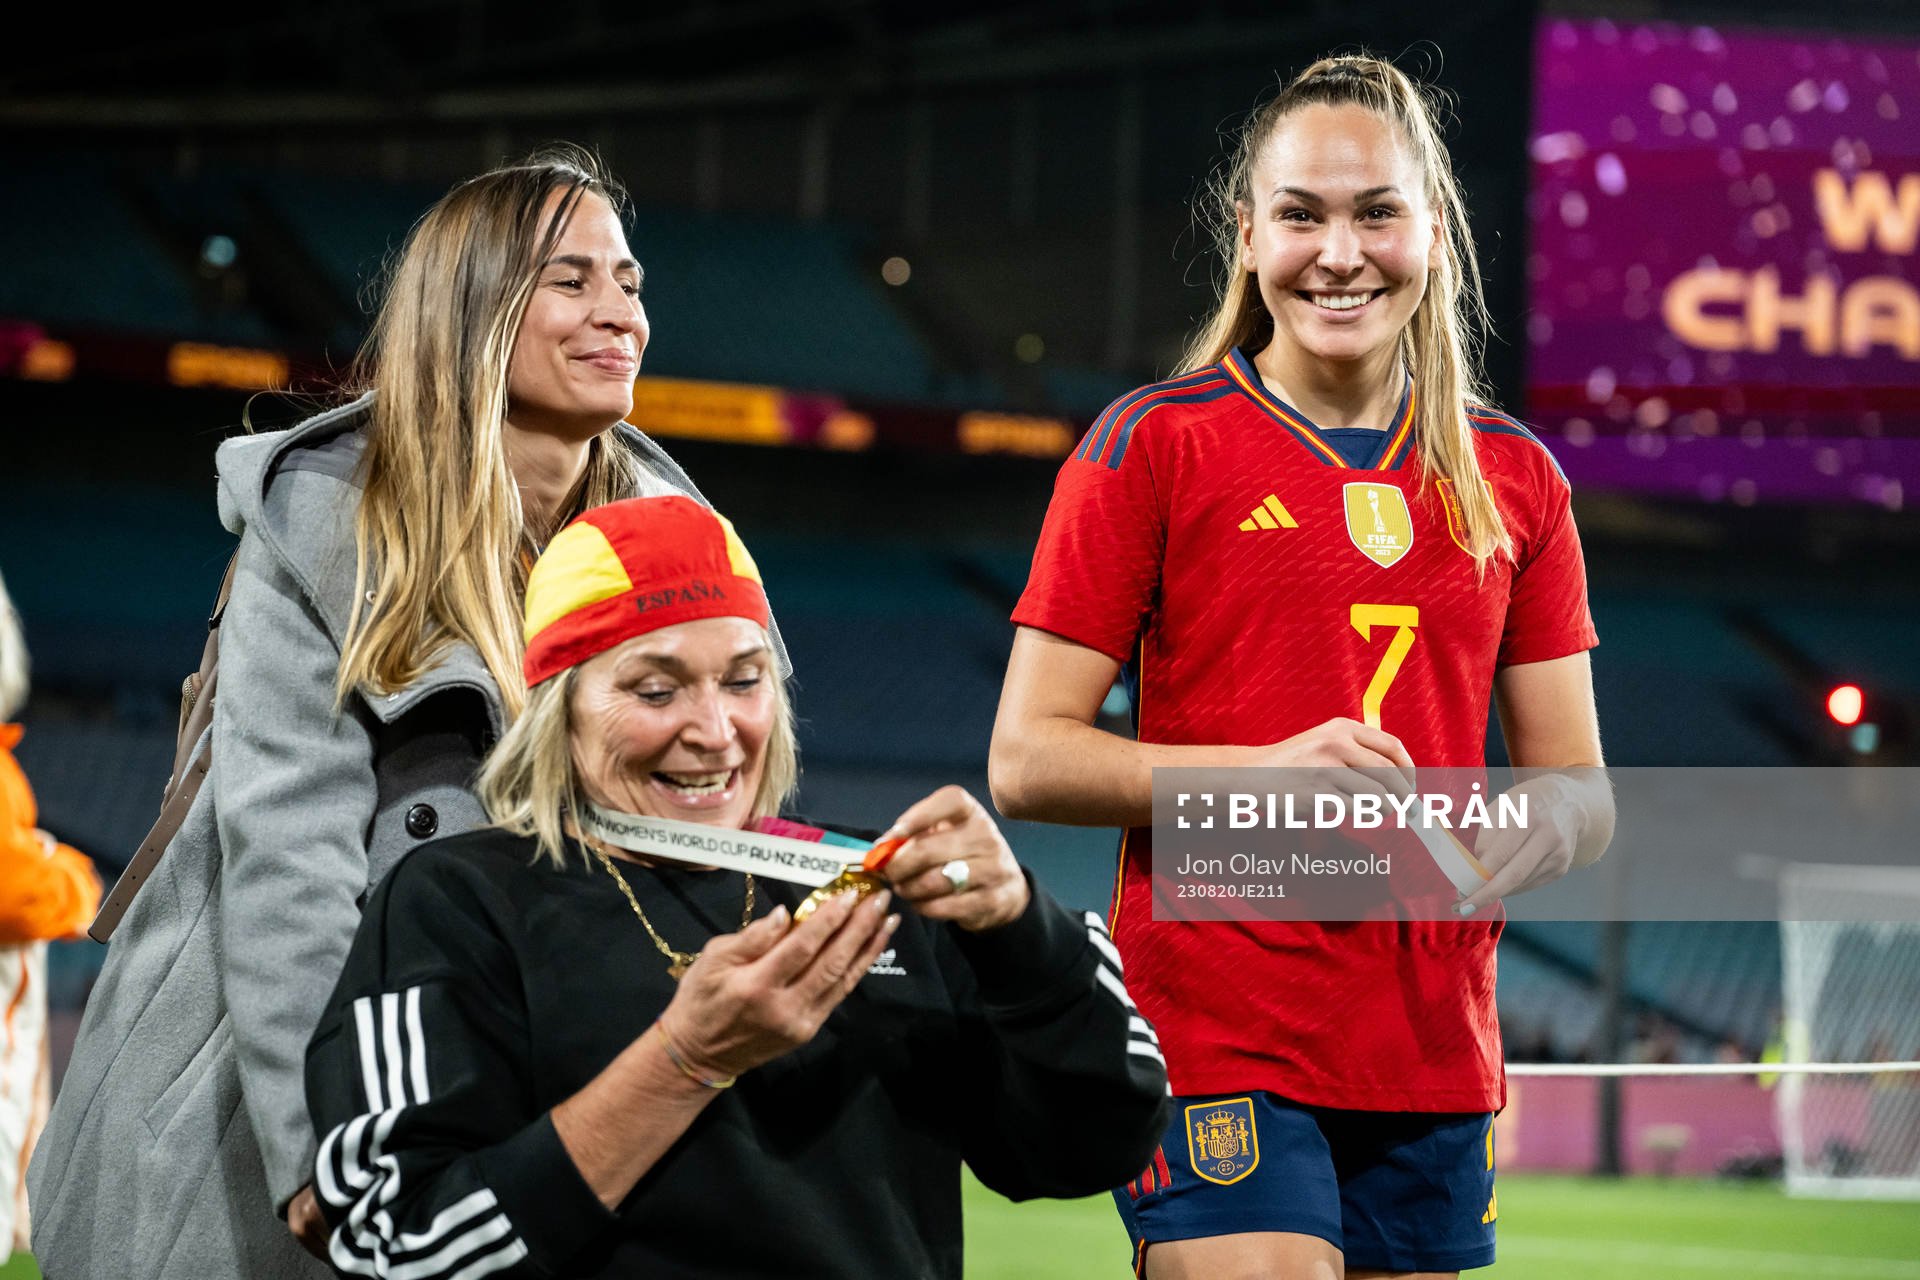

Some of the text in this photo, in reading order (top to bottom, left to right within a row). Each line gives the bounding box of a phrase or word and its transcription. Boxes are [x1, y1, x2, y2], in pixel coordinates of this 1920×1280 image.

[1367, 534, 1395, 545] FIFA
[636, 579, 726, 613] ESPAÑA
[1350, 603, 1419, 730] 7
[605, 819, 668, 843] WOMEN'S
[669, 831, 719, 852] WORLD
[720, 840, 748, 856] CUP
